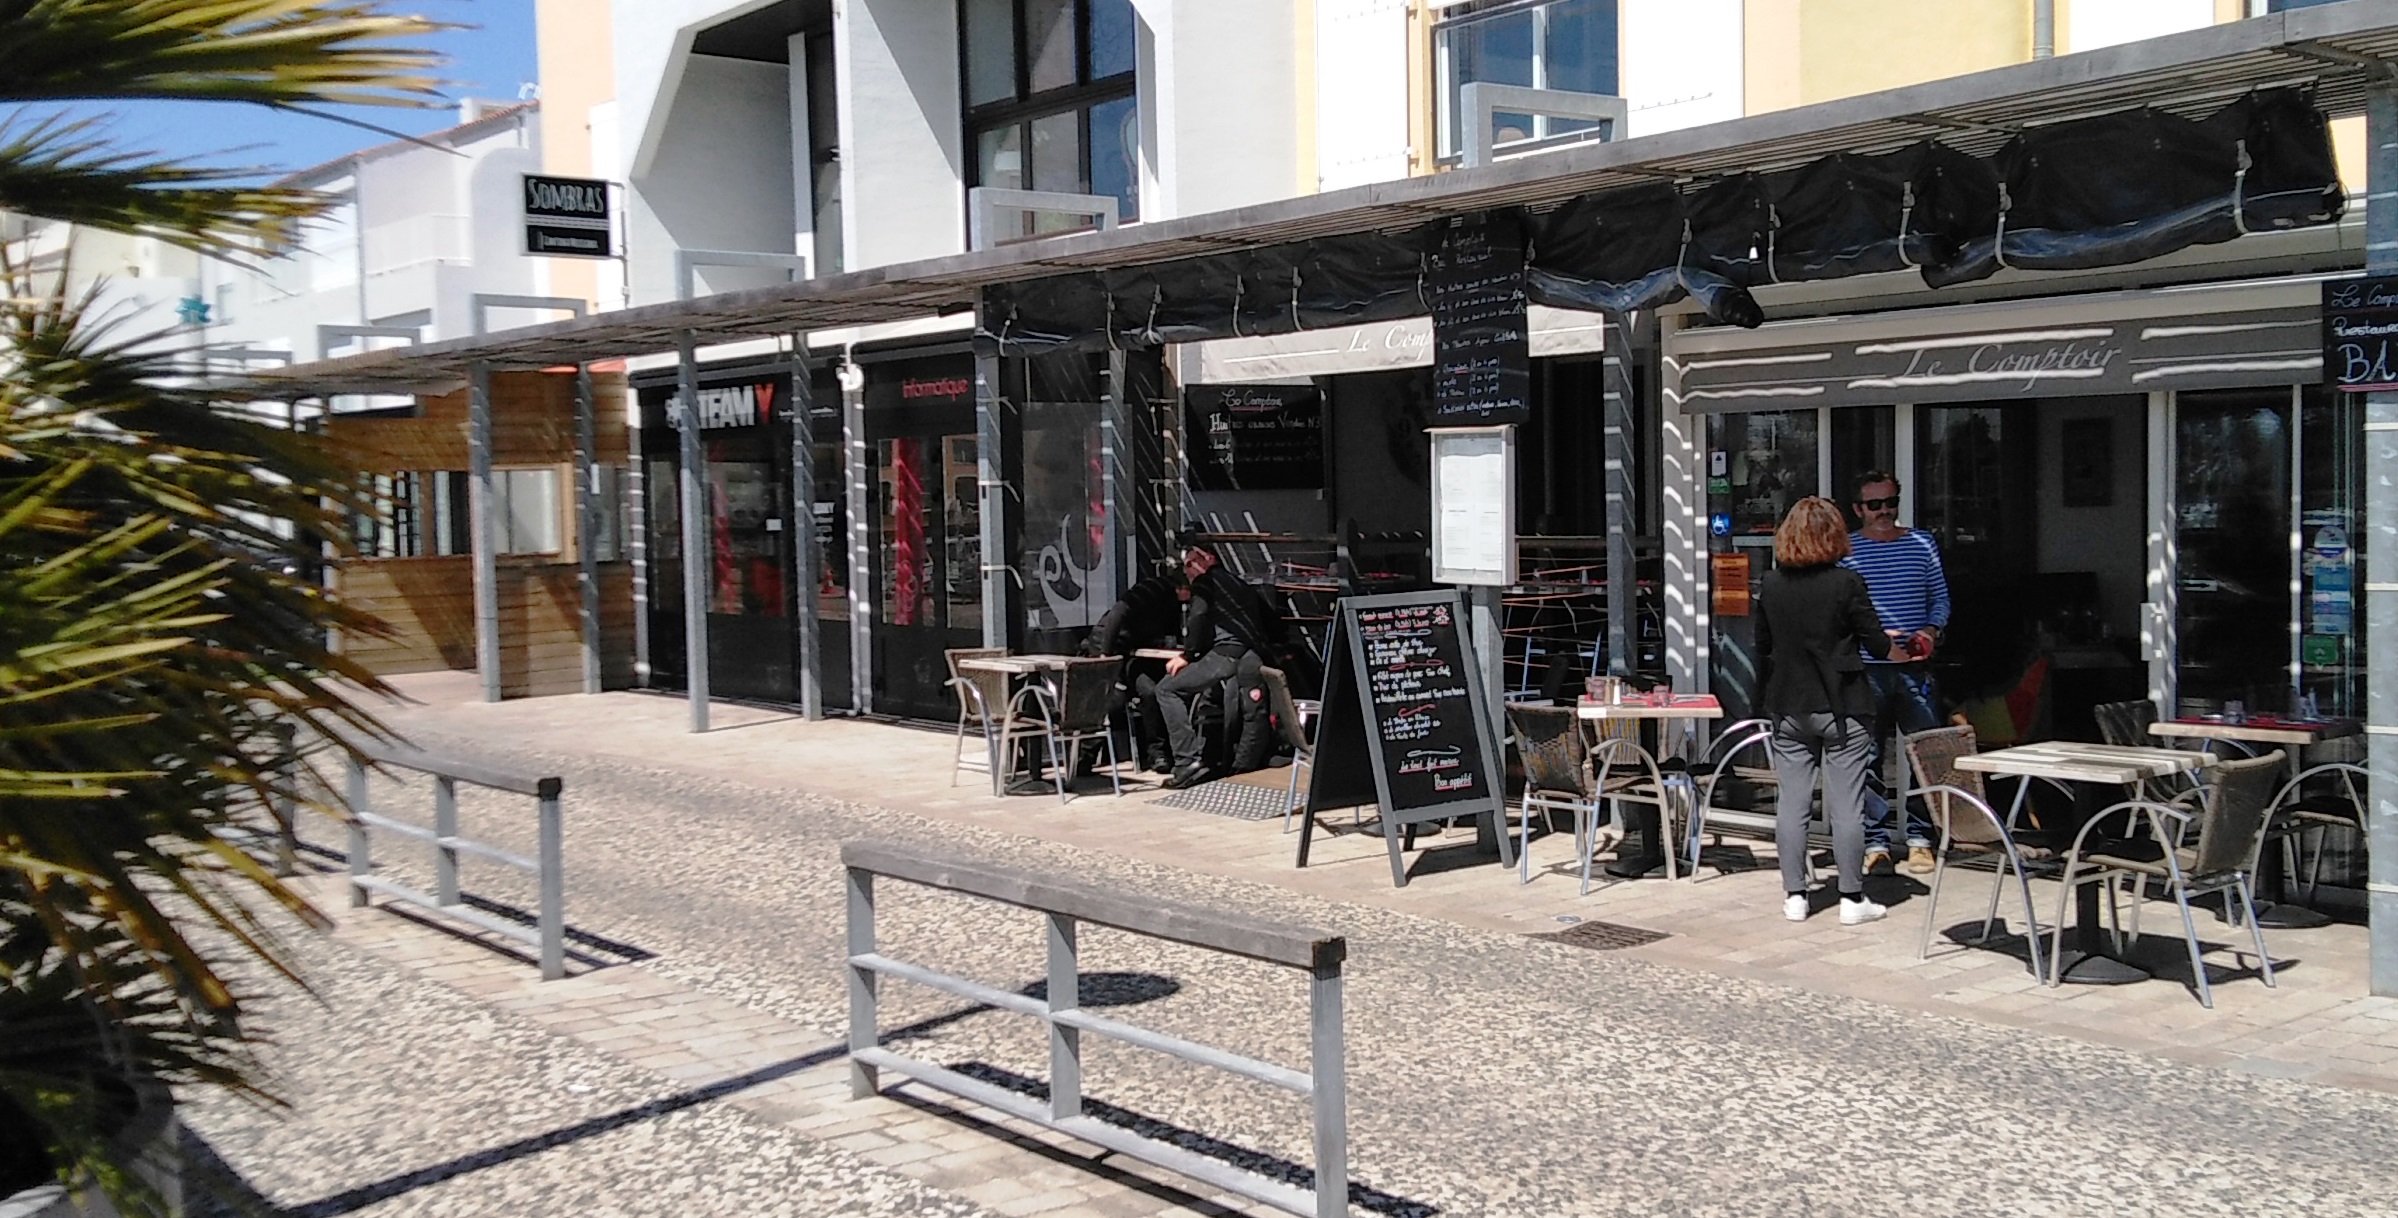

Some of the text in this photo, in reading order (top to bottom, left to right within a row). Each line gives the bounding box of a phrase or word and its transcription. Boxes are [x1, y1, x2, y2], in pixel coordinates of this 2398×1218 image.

[528, 179, 604, 213] SOMBRAS
[2331, 284, 2398, 308] Le Comp
[1347, 329, 1371, 353] Le
[1903, 340, 2122, 393] Le Comptoir
[2338, 340, 2398, 382] BA
[1433, 772, 1448, 789] Bon
